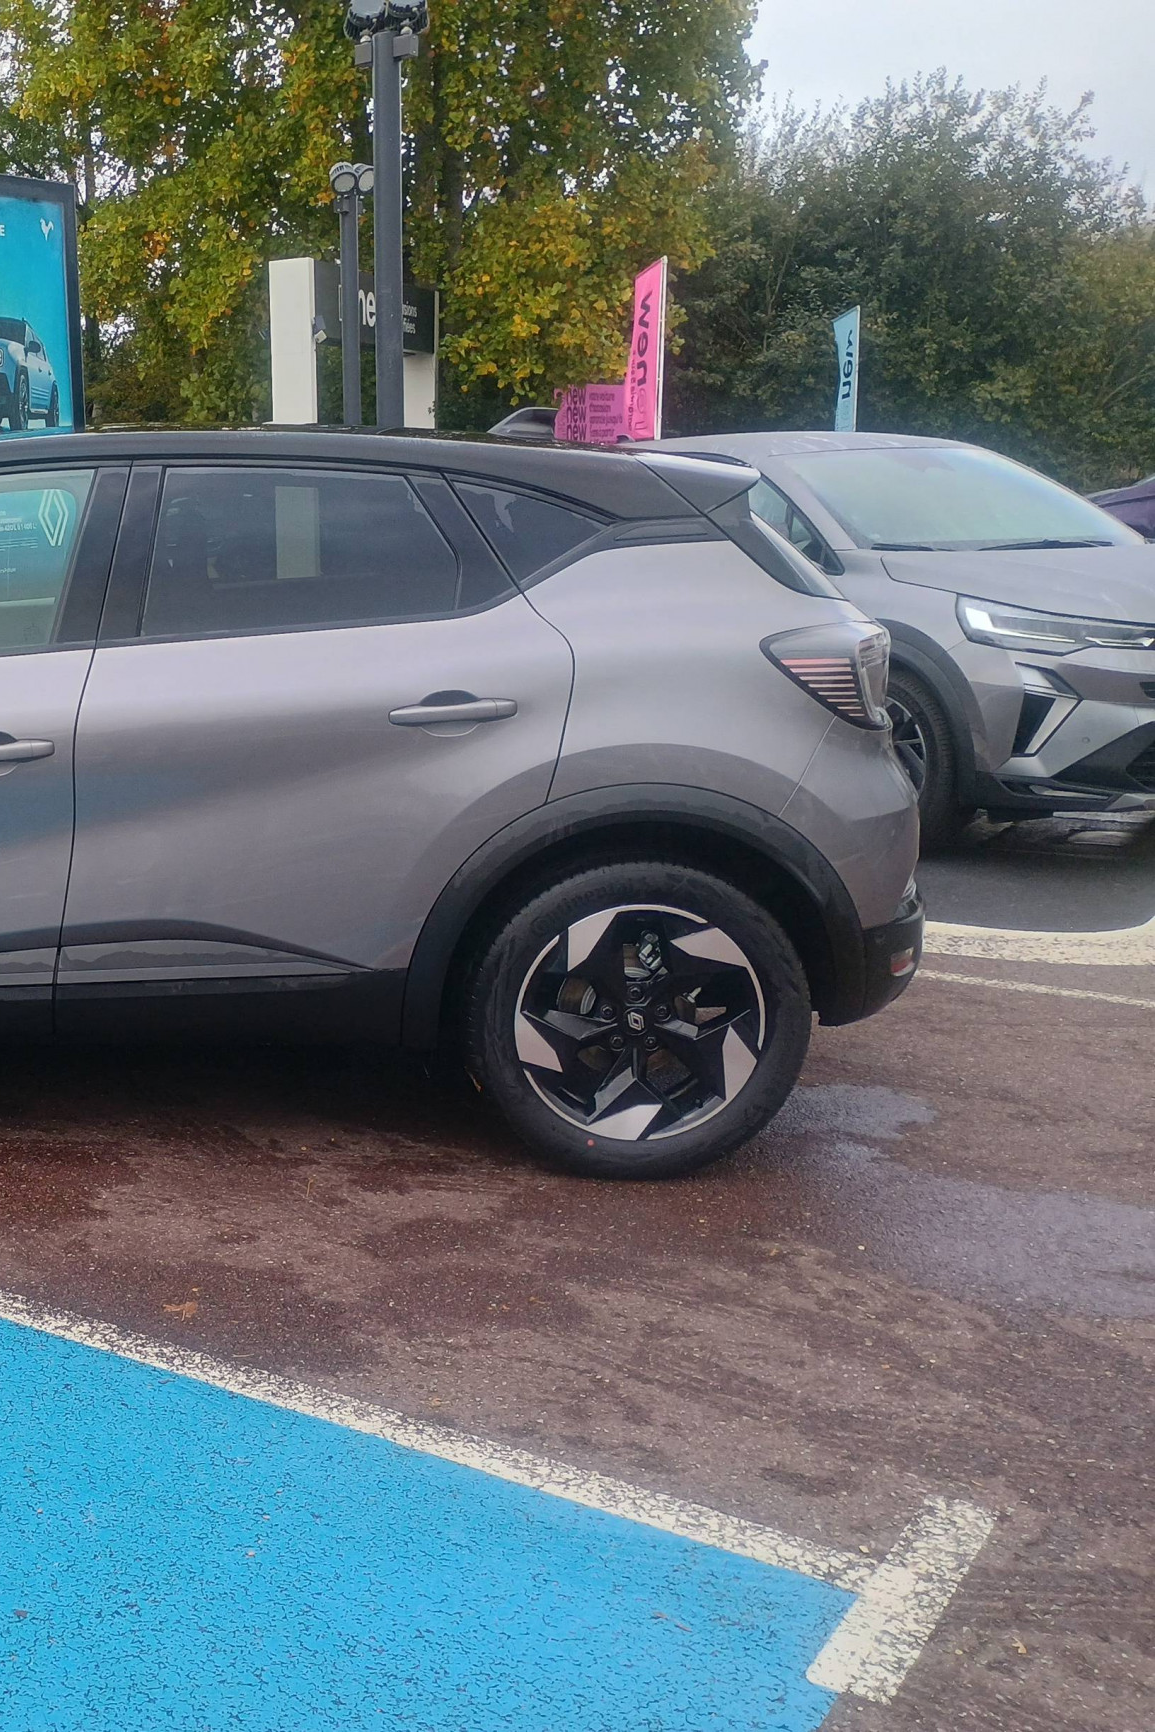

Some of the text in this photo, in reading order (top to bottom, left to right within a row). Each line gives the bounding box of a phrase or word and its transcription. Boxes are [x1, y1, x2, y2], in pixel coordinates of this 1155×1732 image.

[566, 387, 586, 405] new
[566, 406, 586, 423] new
[566, 423, 587, 440] new
